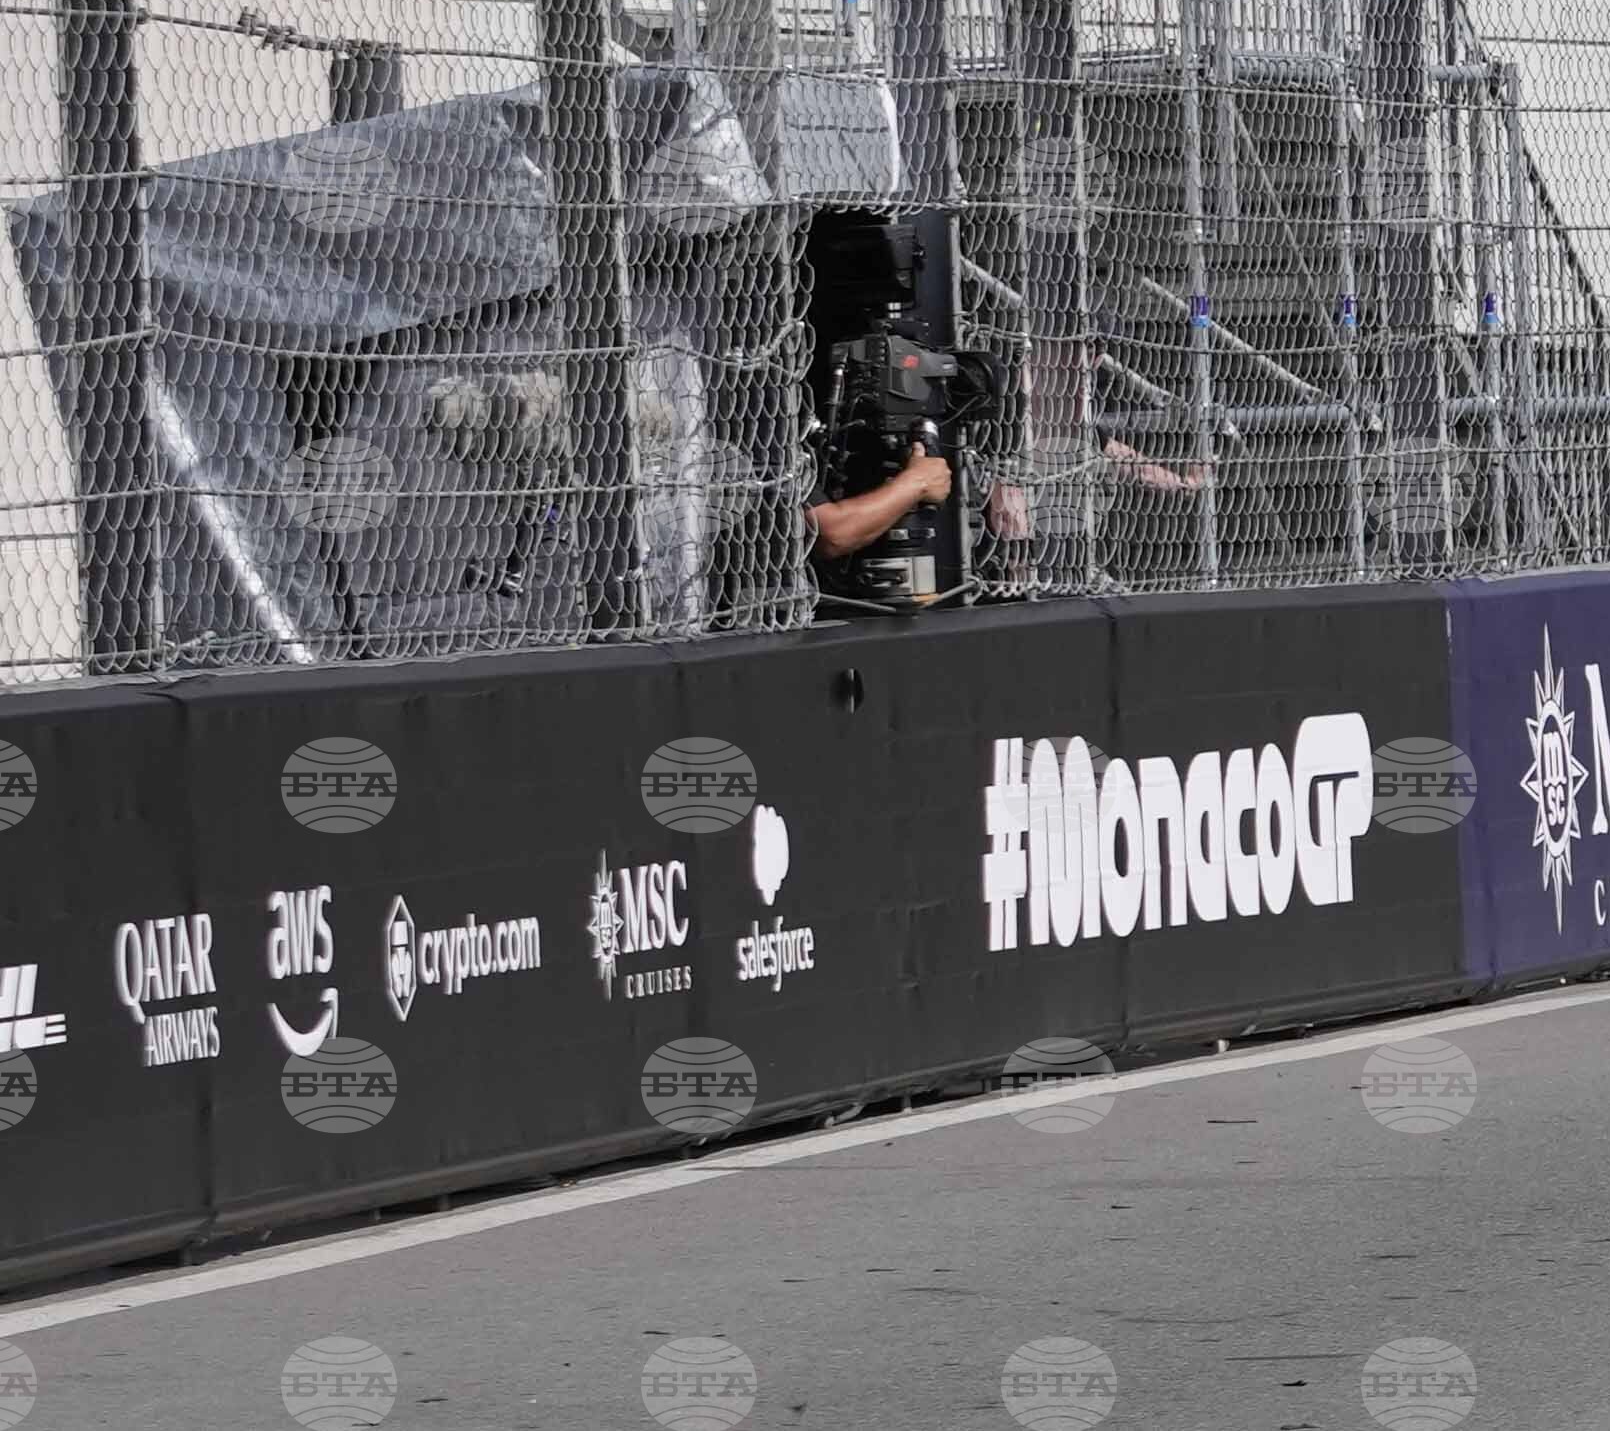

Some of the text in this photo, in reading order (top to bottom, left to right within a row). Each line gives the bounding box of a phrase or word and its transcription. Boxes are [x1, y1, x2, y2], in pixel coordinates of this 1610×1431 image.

[267, 885, 335, 980] aws
[619, 860, 690, 954] MSC
[114, 913, 217, 1025] QATAR
[419, 913, 541, 995] crypto.com
[624, 965, 693, 999] CRUISES
[735, 915, 815, 993] salesforce
[143, 1006, 221, 1067] AIRWAYS
